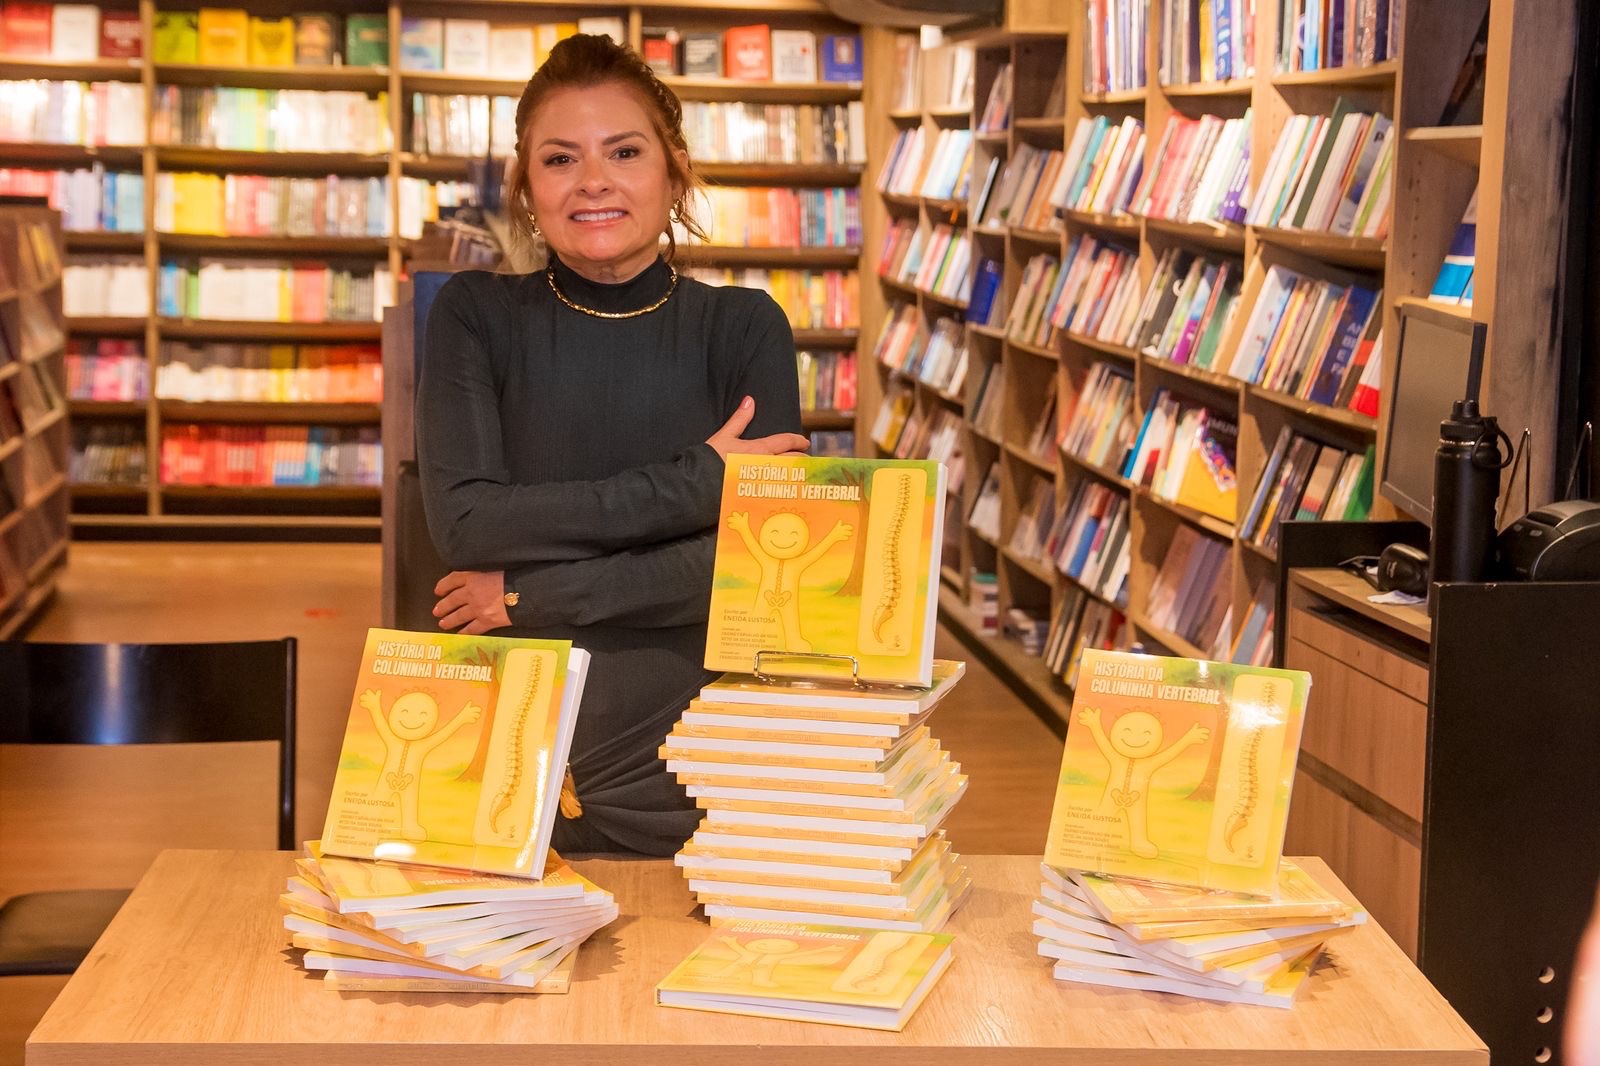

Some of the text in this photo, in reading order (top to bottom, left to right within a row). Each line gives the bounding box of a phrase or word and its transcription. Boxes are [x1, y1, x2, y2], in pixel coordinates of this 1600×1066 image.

[738, 464, 806, 482] HISTÓRIA DA
[737, 483, 861, 501] COLUNINHA VERTEBRAL
[376, 641, 442, 661] HISTÓRIA DA
[373, 659, 493, 682] COLUNINHA VERTEBRAL
[1094, 661, 1164, 682] HISTÓRIA DA
[1091, 679, 1221, 705] COLUNINHA VERTEBRAL
[1092, 814, 1122, 823] LUSTOSA
